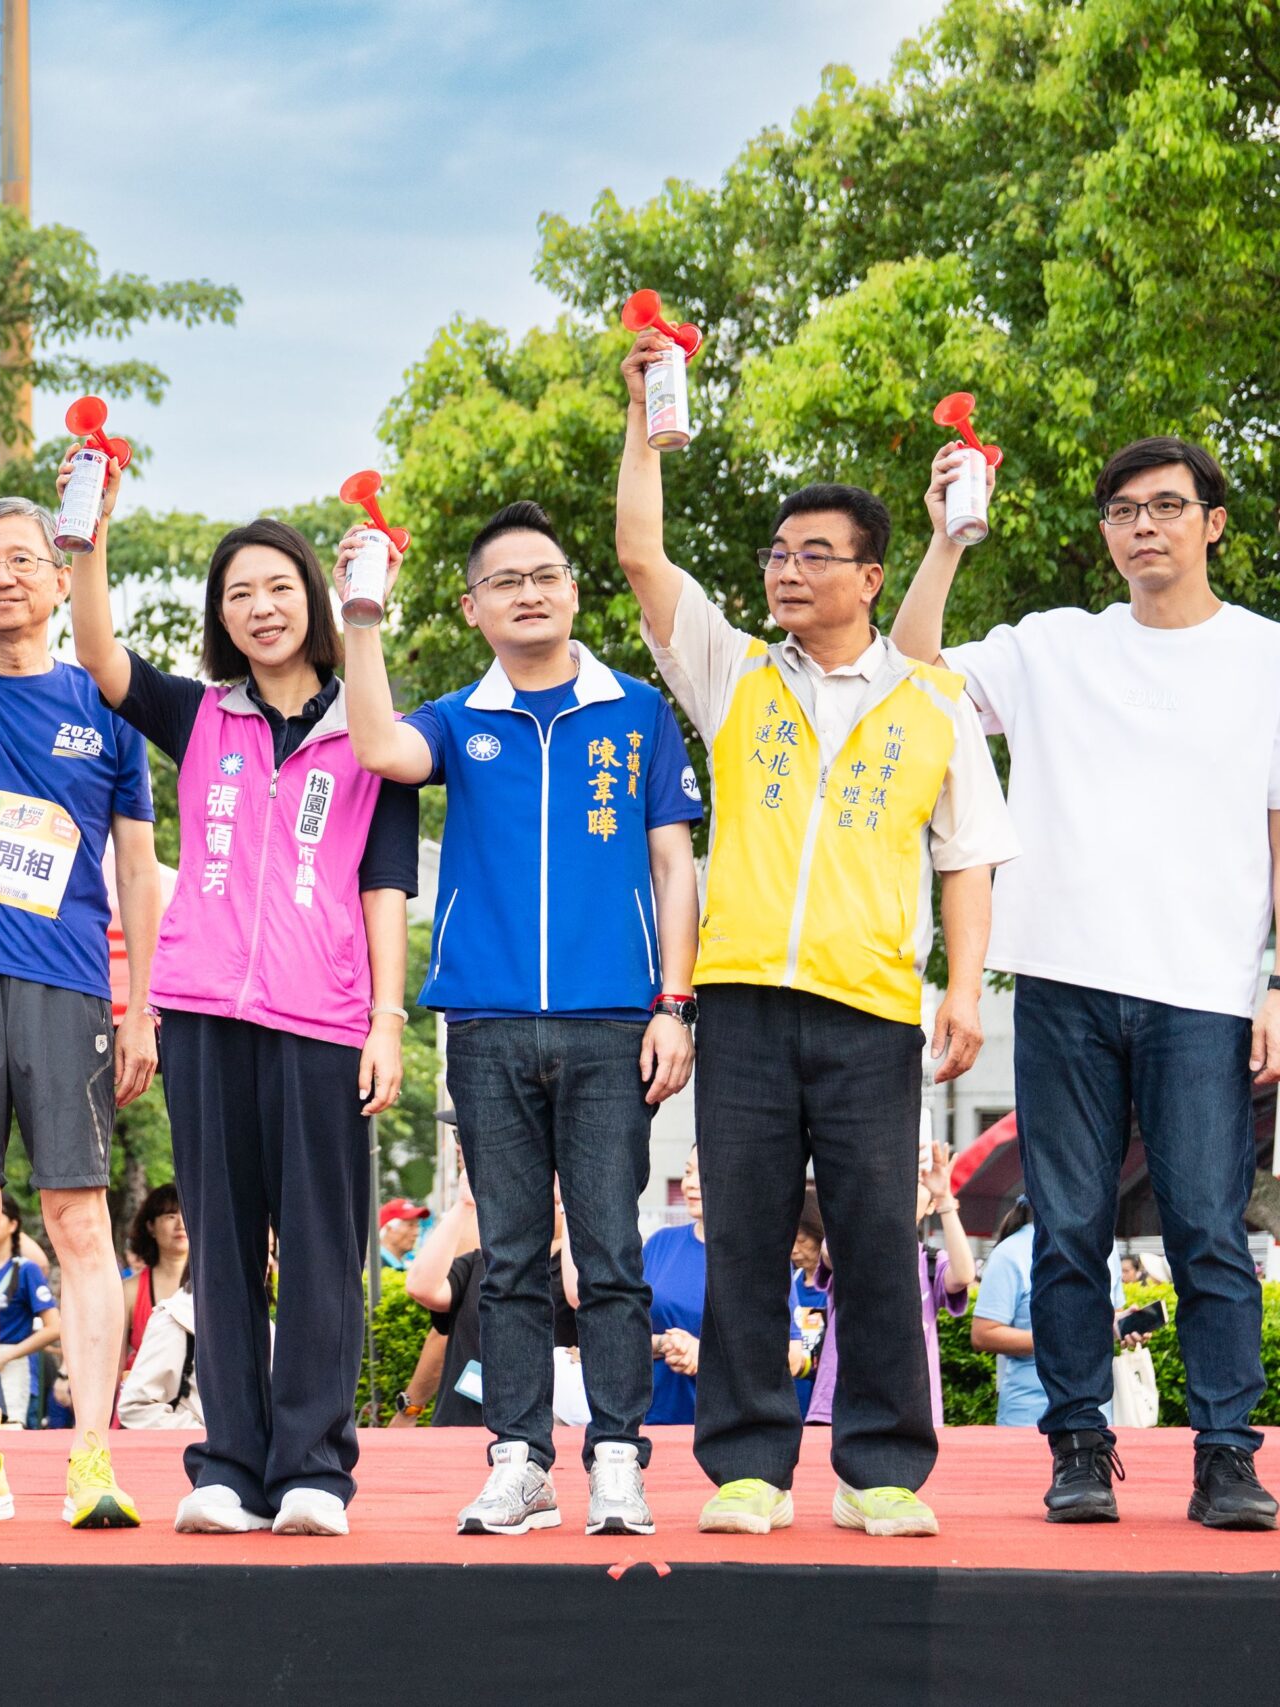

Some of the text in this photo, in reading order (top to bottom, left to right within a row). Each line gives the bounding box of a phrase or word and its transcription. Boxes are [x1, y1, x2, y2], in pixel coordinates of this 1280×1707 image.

[626, 729, 644, 799] 市議員
[760, 720, 799, 809] 張兆恩
[838, 760, 867, 828] 中壢區
[866, 722, 906, 831] 桃園市議員
[201, 784, 240, 896] 張碩芳
[294, 774, 330, 909] 桃園區 市議員
